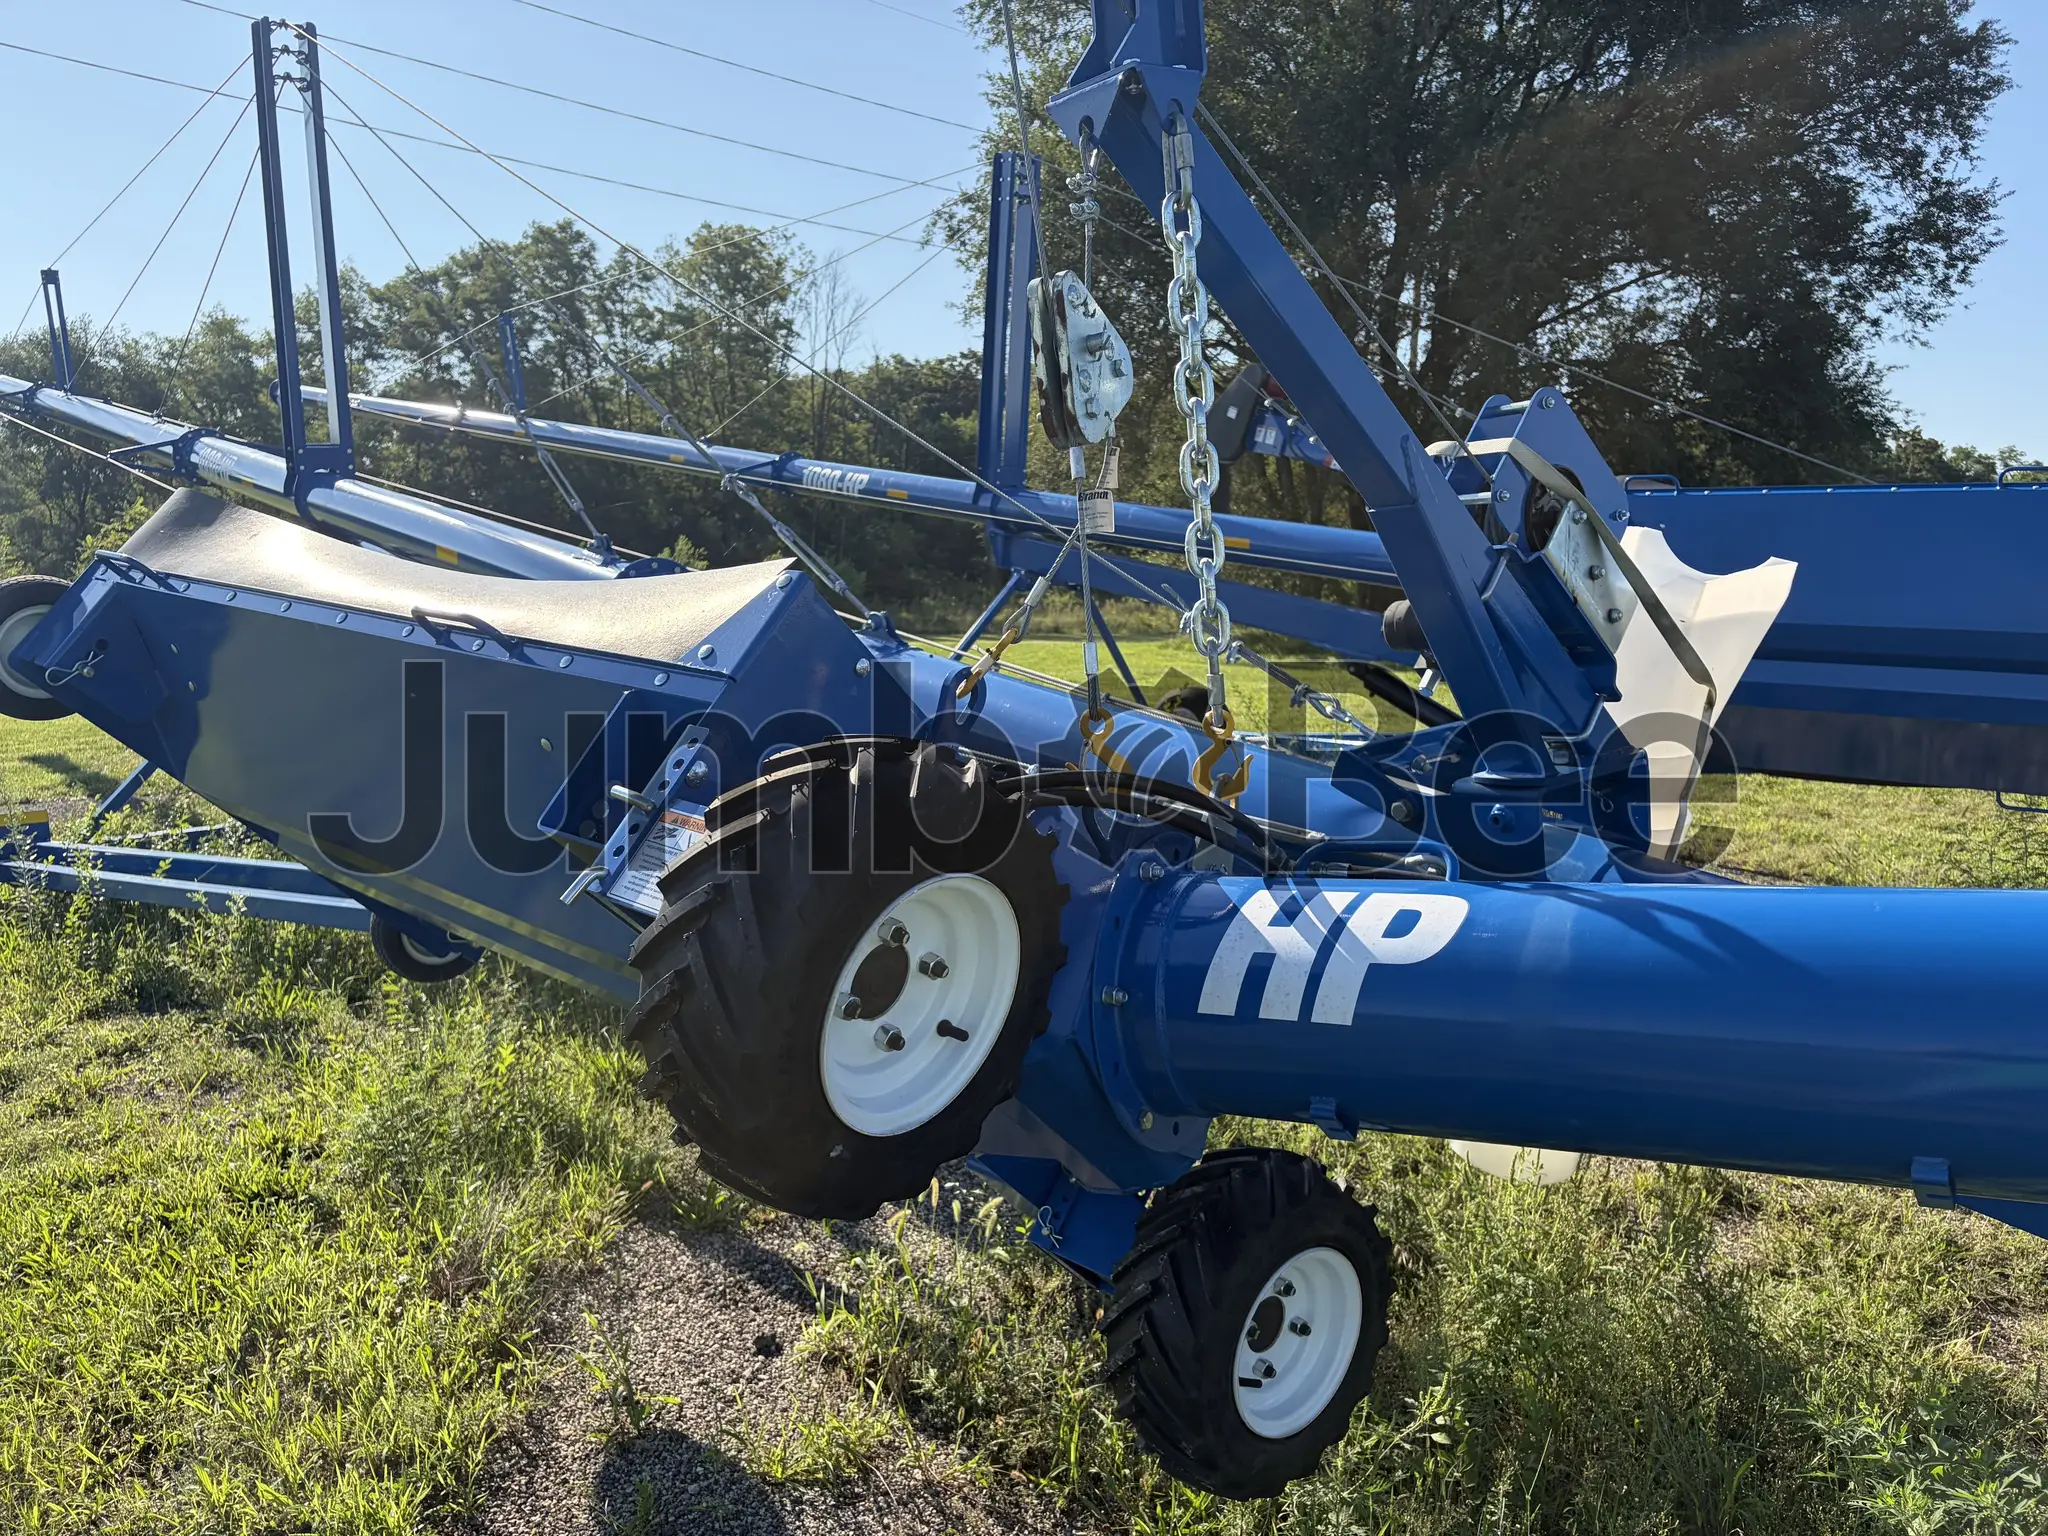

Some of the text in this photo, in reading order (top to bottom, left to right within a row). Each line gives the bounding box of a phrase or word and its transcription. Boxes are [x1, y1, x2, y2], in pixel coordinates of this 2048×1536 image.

[1078, 491, 1109, 502] Brandt
[680, 817, 706, 833] WARNIN
[1197, 889, 1470, 1026] HP
